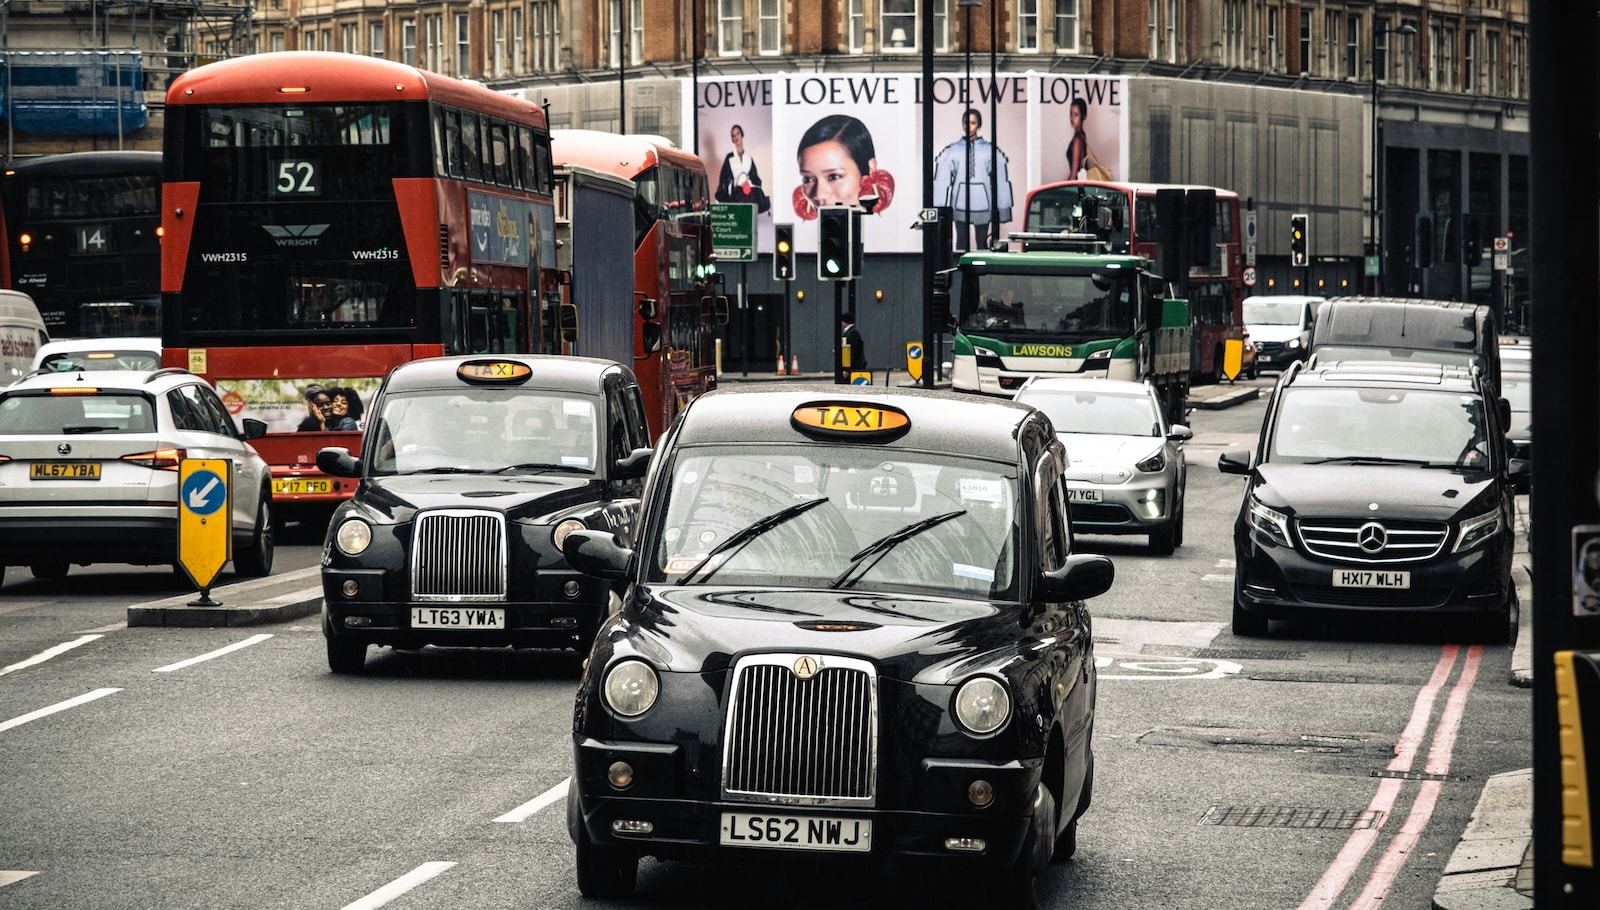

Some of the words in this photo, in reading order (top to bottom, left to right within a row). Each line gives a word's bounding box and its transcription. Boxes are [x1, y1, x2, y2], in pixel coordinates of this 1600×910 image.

[785, 77, 899, 104] LOEWE
[914, 77, 1028, 104] LOEWE
[1040, 77, 1120, 105] LOEWE
[277, 162, 315, 193] 52
[82, 229, 106, 250] 14
[275, 238, 319, 246] WRIGHT
[202, 252, 247, 262] VWH2315
[352, 250, 399, 260] VWH2315
[1245, 272, 1256, 281] 20
[1012, 345, 1072, 357] LAWSONS
[474, 364, 514, 376] TAXI
[817, 408, 883, 427] TAXI
[35, 464, 68, 476] ML67
[72, 464, 95, 476] YBA
[276, 482, 300, 492] LK17
[1079, 490, 1098, 500] YGL
[1341, 572, 1372, 585] HX17
[1376, 573, 1403, 586] WLH
[418, 609, 460, 625] LT63
[465, 610, 497, 626] YWA
[798, 657, 812, 674] A
[730, 815, 800, 843] LS62
[807, 819, 860, 846] NWJ
